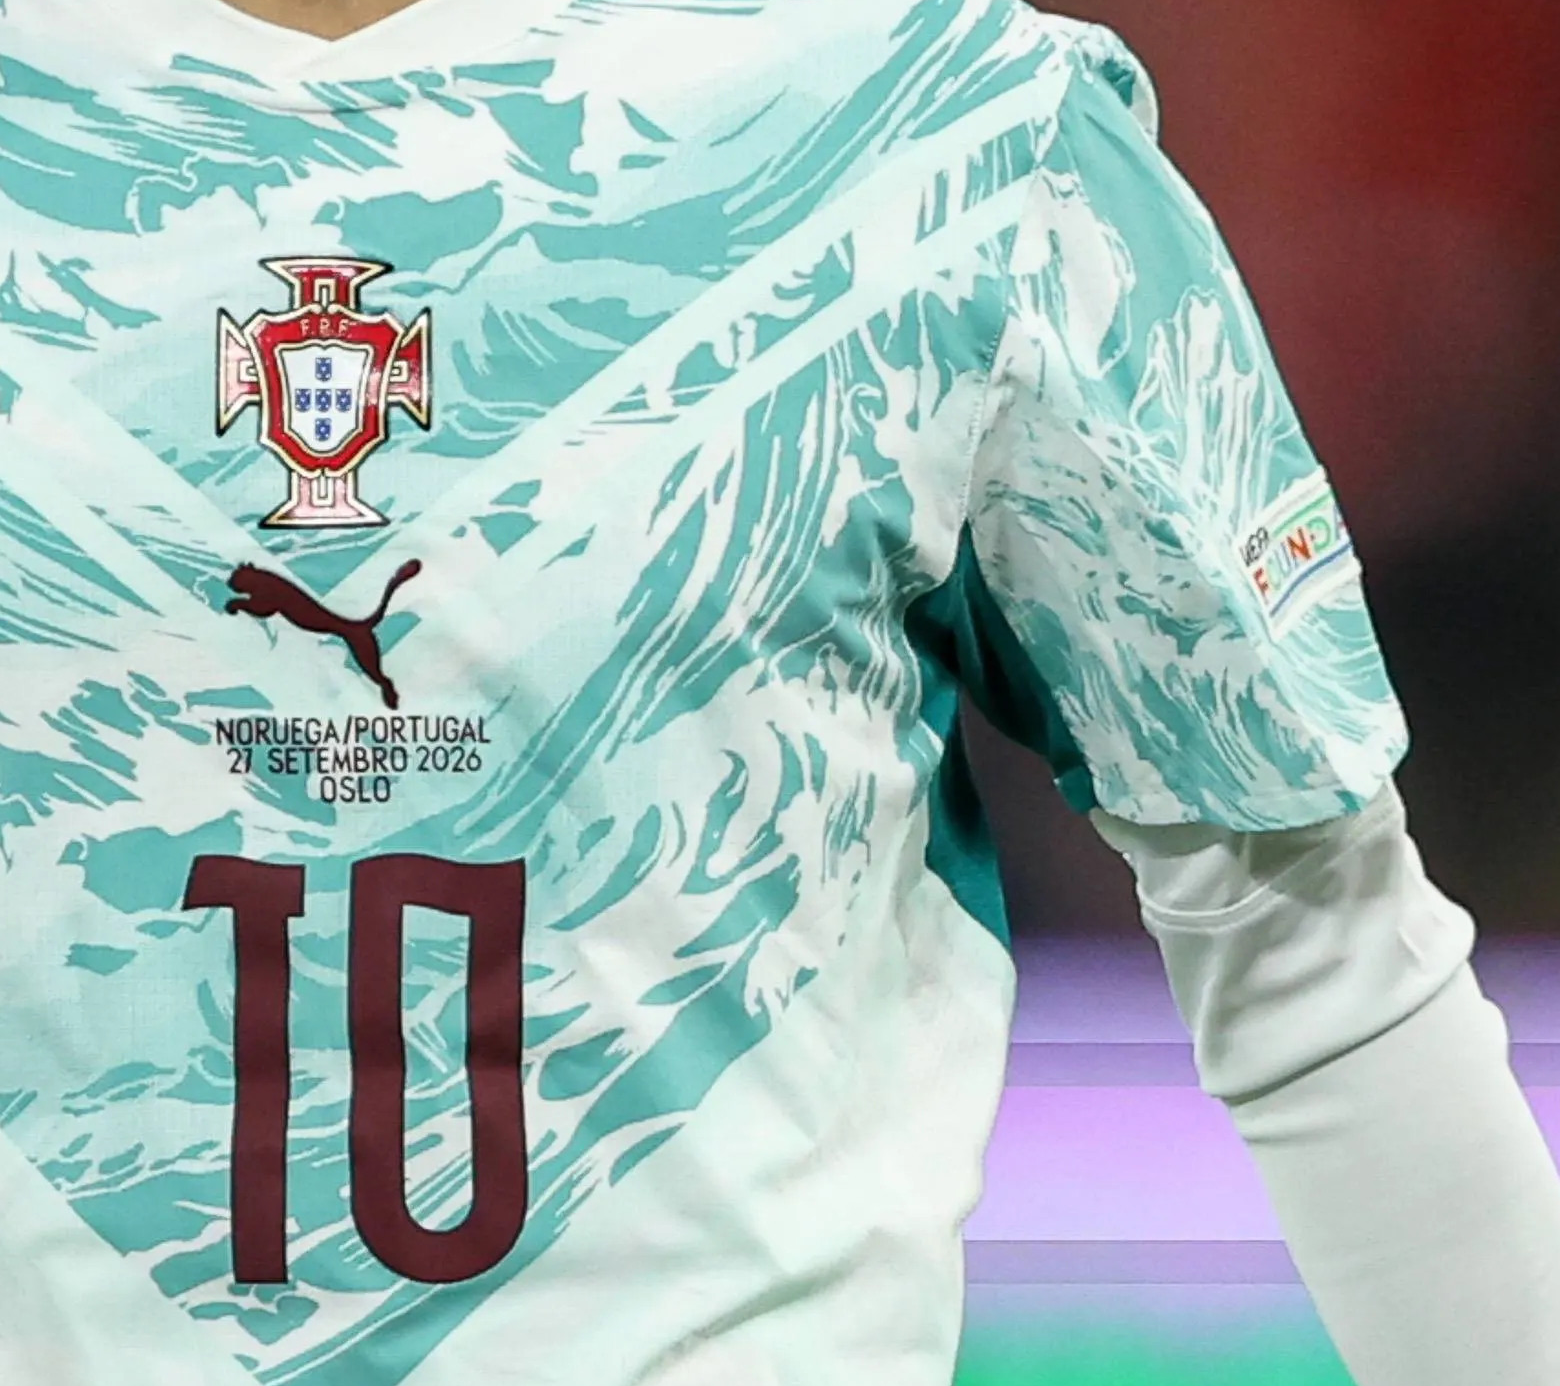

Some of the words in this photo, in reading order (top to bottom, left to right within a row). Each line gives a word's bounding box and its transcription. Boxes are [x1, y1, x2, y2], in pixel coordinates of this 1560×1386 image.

[216, 715, 491, 746] NORUEGA/PORTUGAL
[267, 746, 408, 775] SETEMBRO
[415, 745, 482, 773] 2026
[320, 775, 391, 803] OSLO
[182, 853, 529, 1284] 10
